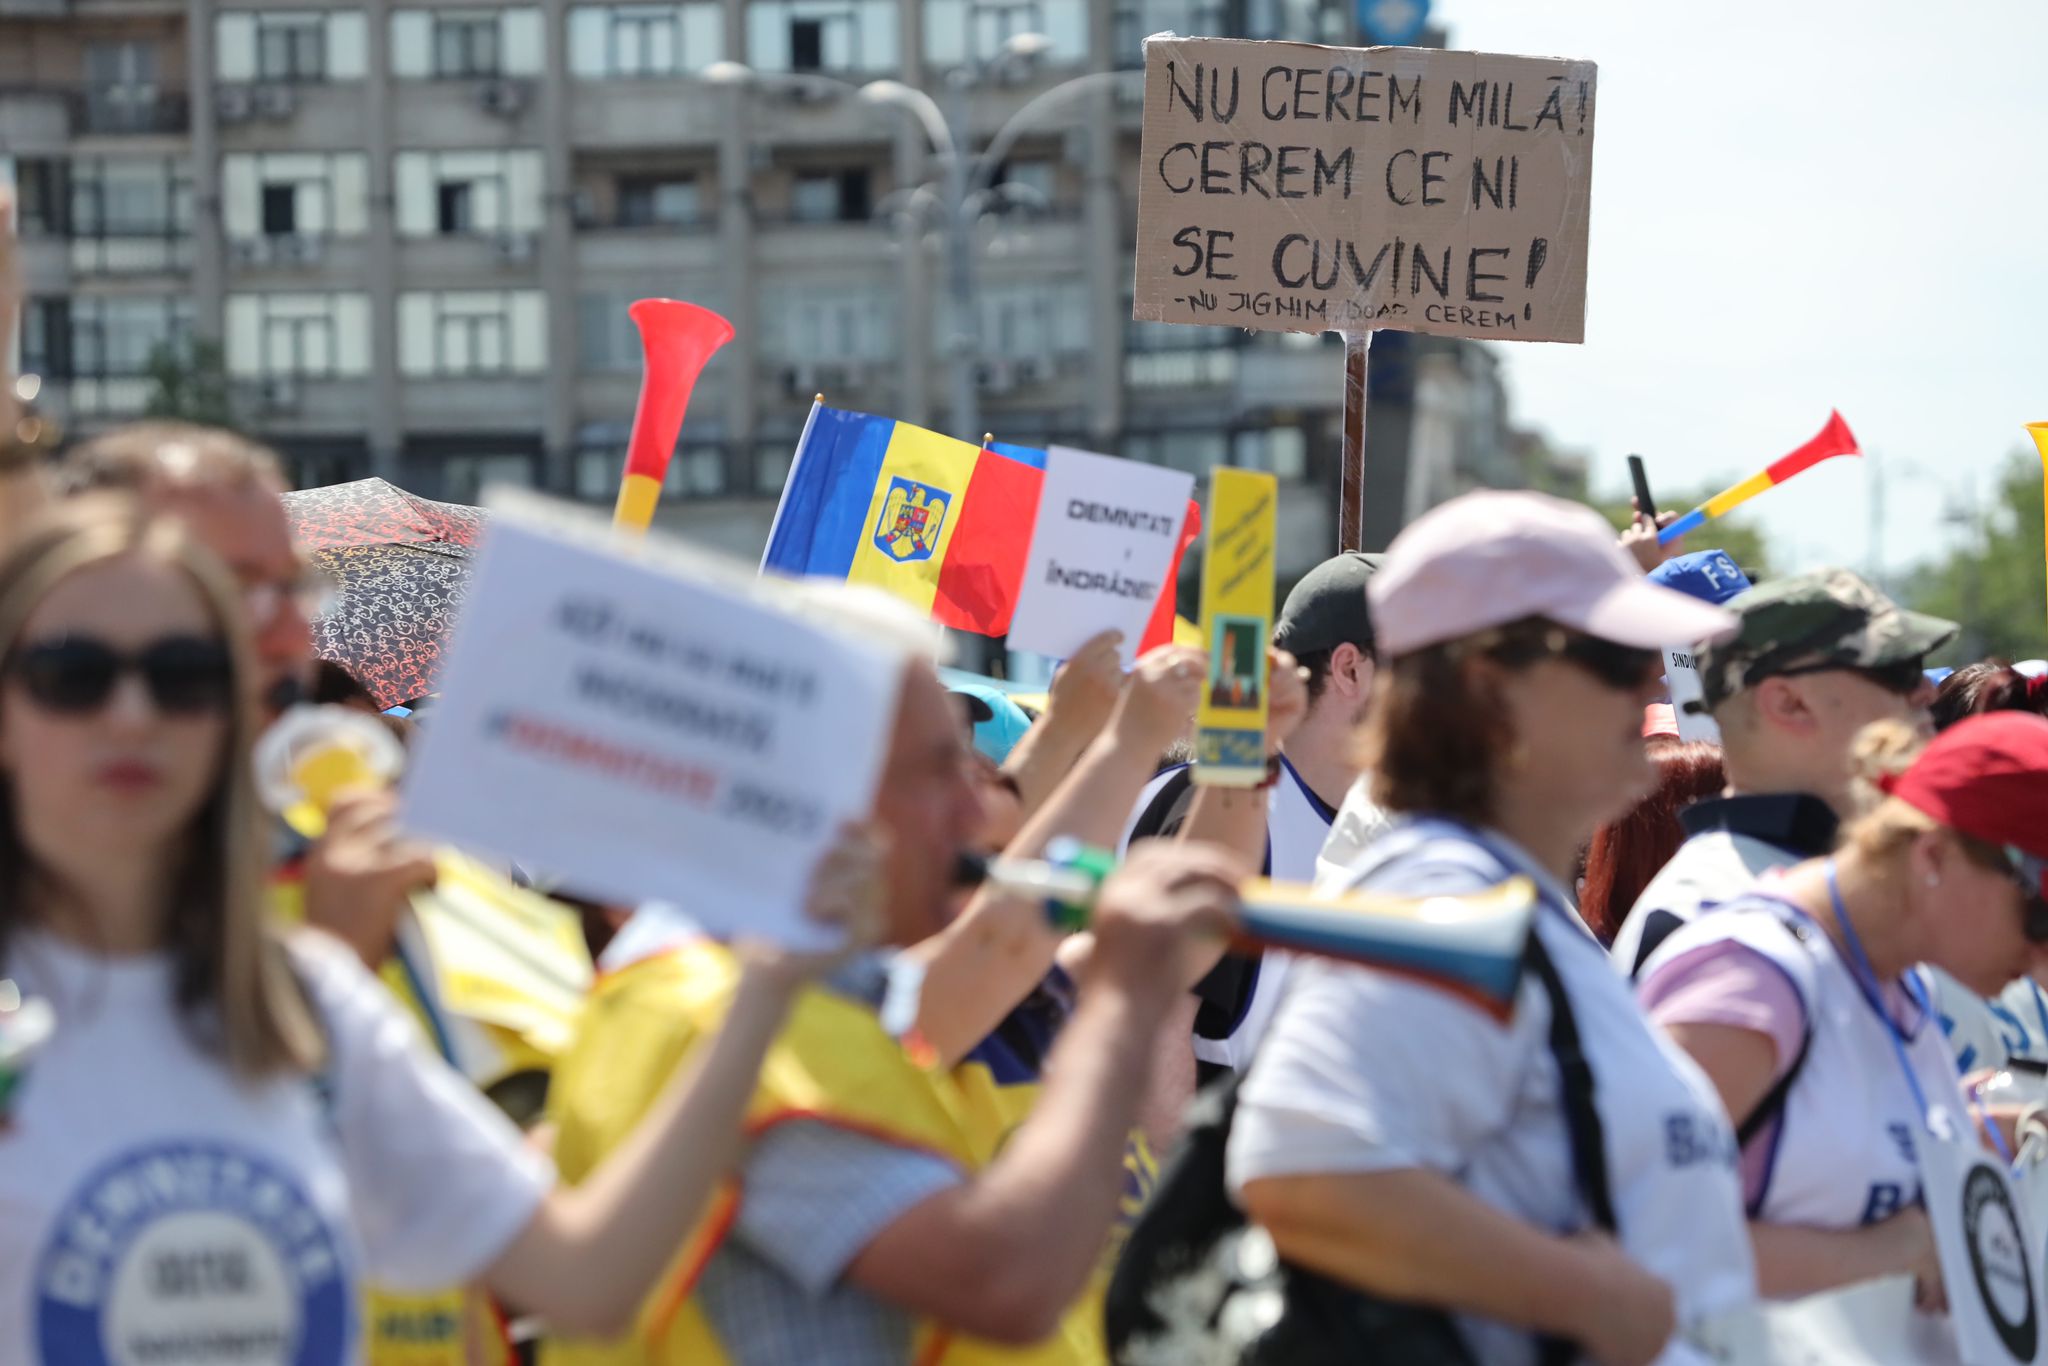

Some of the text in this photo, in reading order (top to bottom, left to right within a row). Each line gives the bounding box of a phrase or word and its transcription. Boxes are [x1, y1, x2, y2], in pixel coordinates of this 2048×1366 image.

[1167, 61, 1239, 124] NU
[1262, 66, 1421, 124] CEREM
[1158, 141, 1519, 210] CEREM CE NI
[1172, 226, 1238, 280] SE
